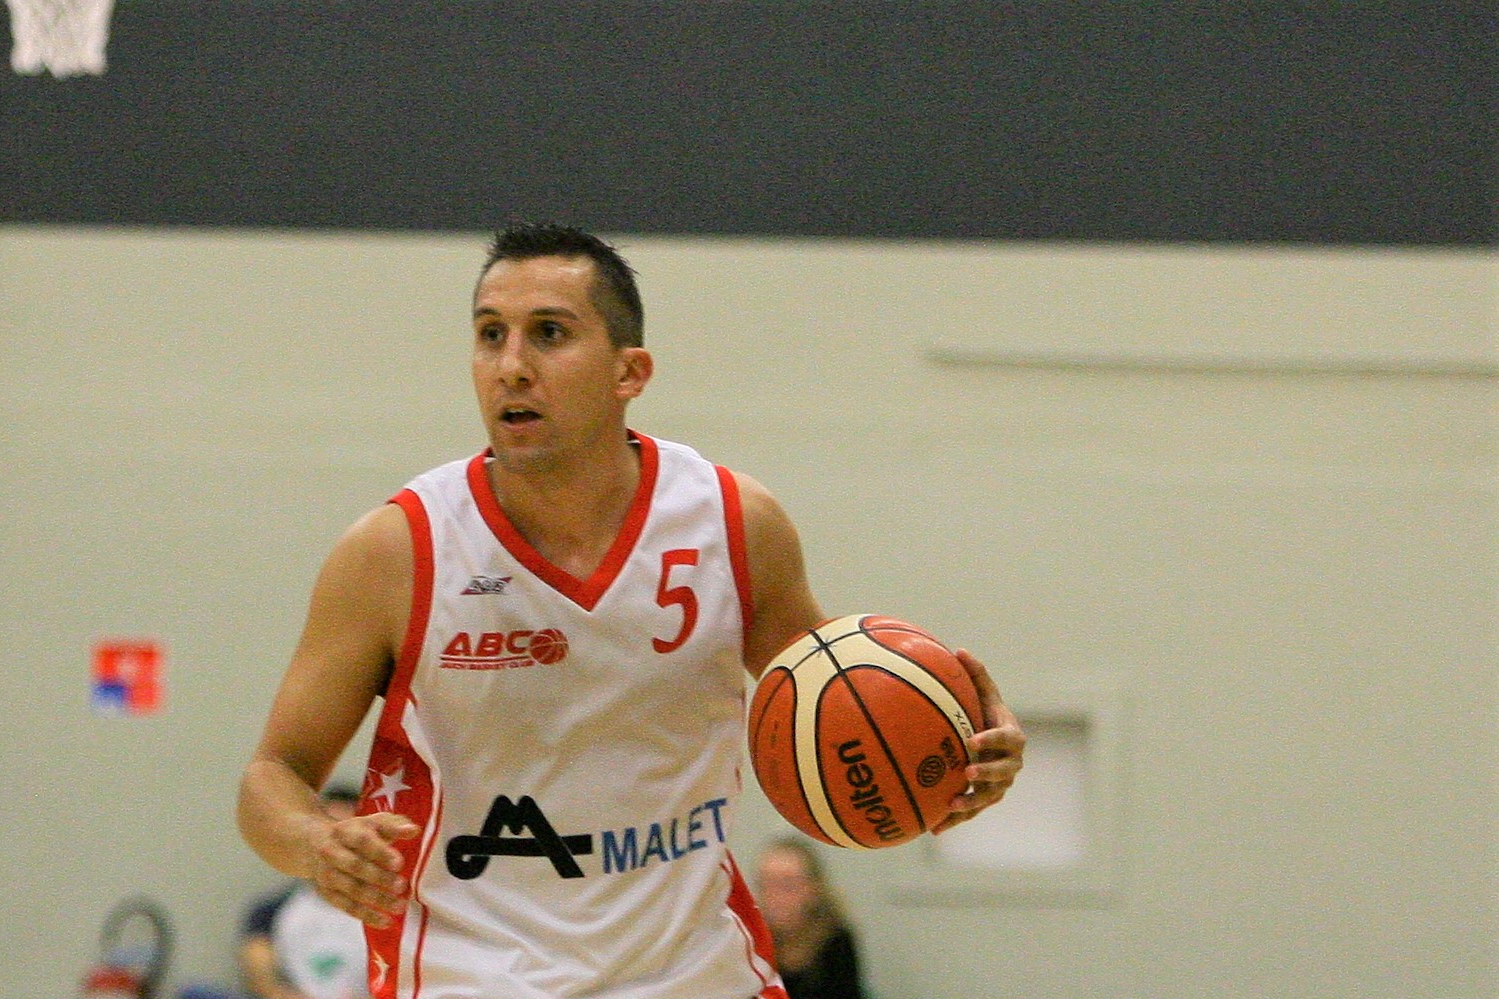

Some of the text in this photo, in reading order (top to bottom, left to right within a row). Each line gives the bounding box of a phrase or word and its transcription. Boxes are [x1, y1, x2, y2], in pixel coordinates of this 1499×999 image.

[652, 548, 700, 654] 5
[601, 797, 728, 875] MALET
[837, 738, 904, 842] molten
